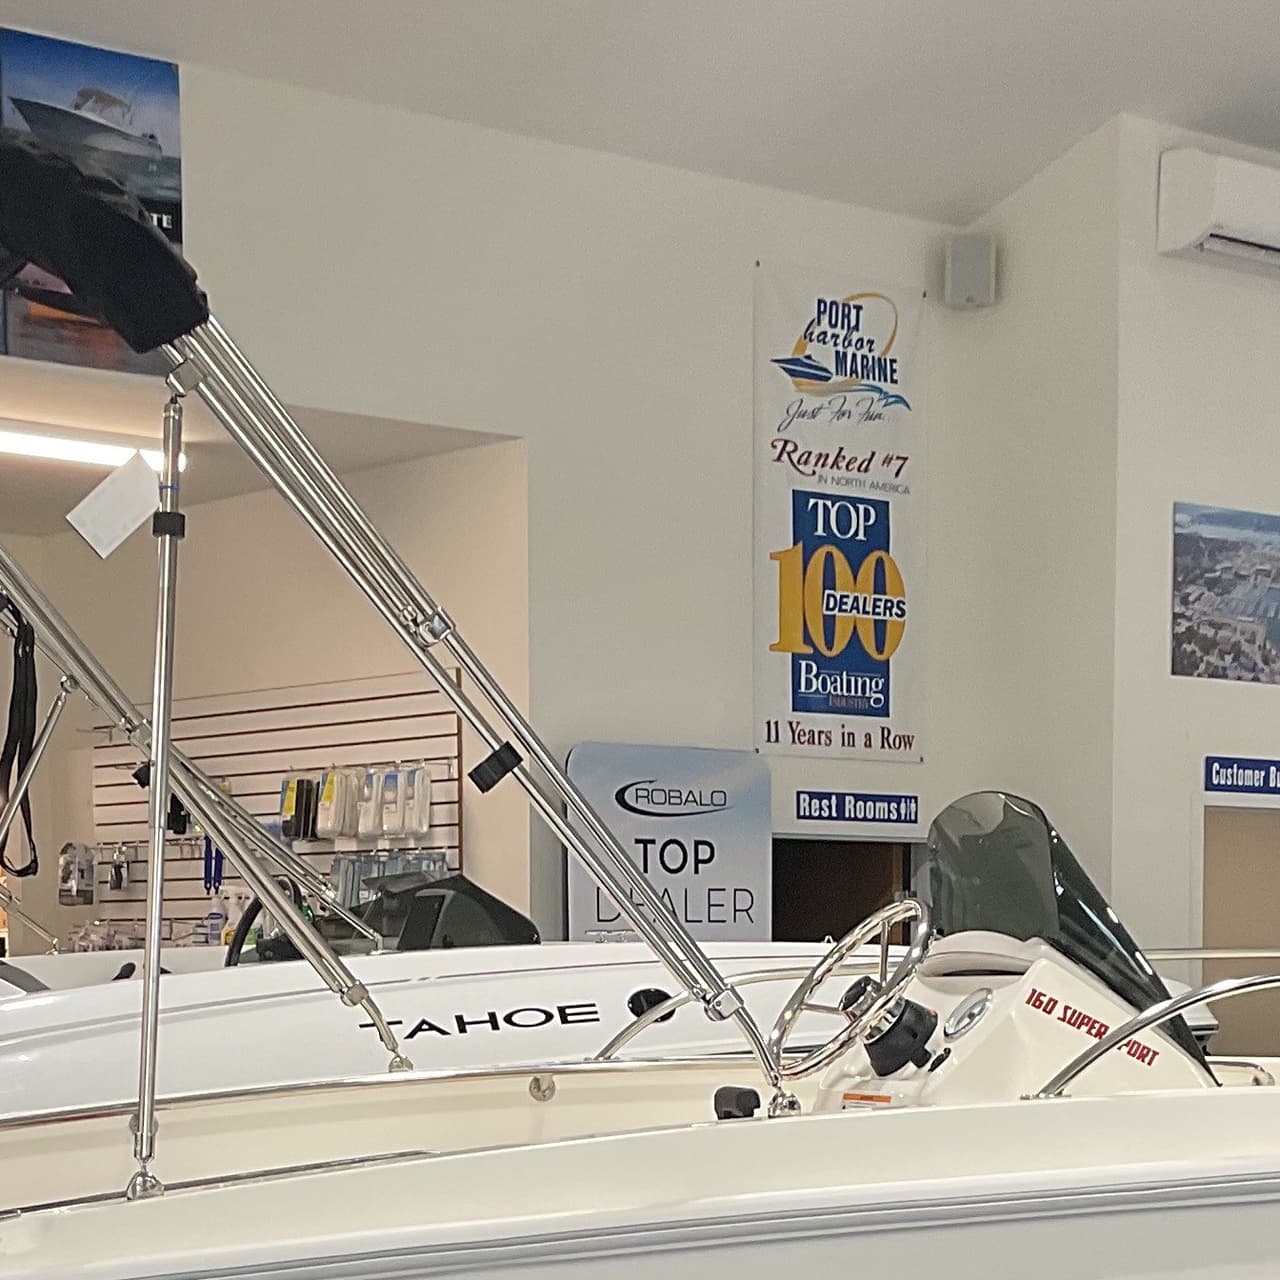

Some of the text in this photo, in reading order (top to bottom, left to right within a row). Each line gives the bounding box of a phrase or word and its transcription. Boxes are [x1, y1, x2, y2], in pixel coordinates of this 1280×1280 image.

[816, 298, 863, 332] PORT
[803, 318, 875, 353] harbor
[834, 350, 898, 384] MARINE
[777, 398, 824, 432] Just
[829, 395, 852, 423] For
[771, 438, 909, 478] Ranked #7
[818, 474, 910, 494] IN NORTH AMERICA
[807, 498, 876, 541] TOP
[768, 540, 907, 662] 100
[824, 592, 907, 618] DEALERS
[798, 660, 885, 708] Boating
[765, 719, 915, 750] 11 Years in a Row
[1212, 762, 1266, 787] Customer
[635, 788, 727, 807] ROBALO
[799, 793, 898, 820] Rest Rooms
[634, 838, 715, 875] TOP
[596, 887, 755, 923] DALER
[1024, 988, 1159, 1066] 160 SUPER PORT
